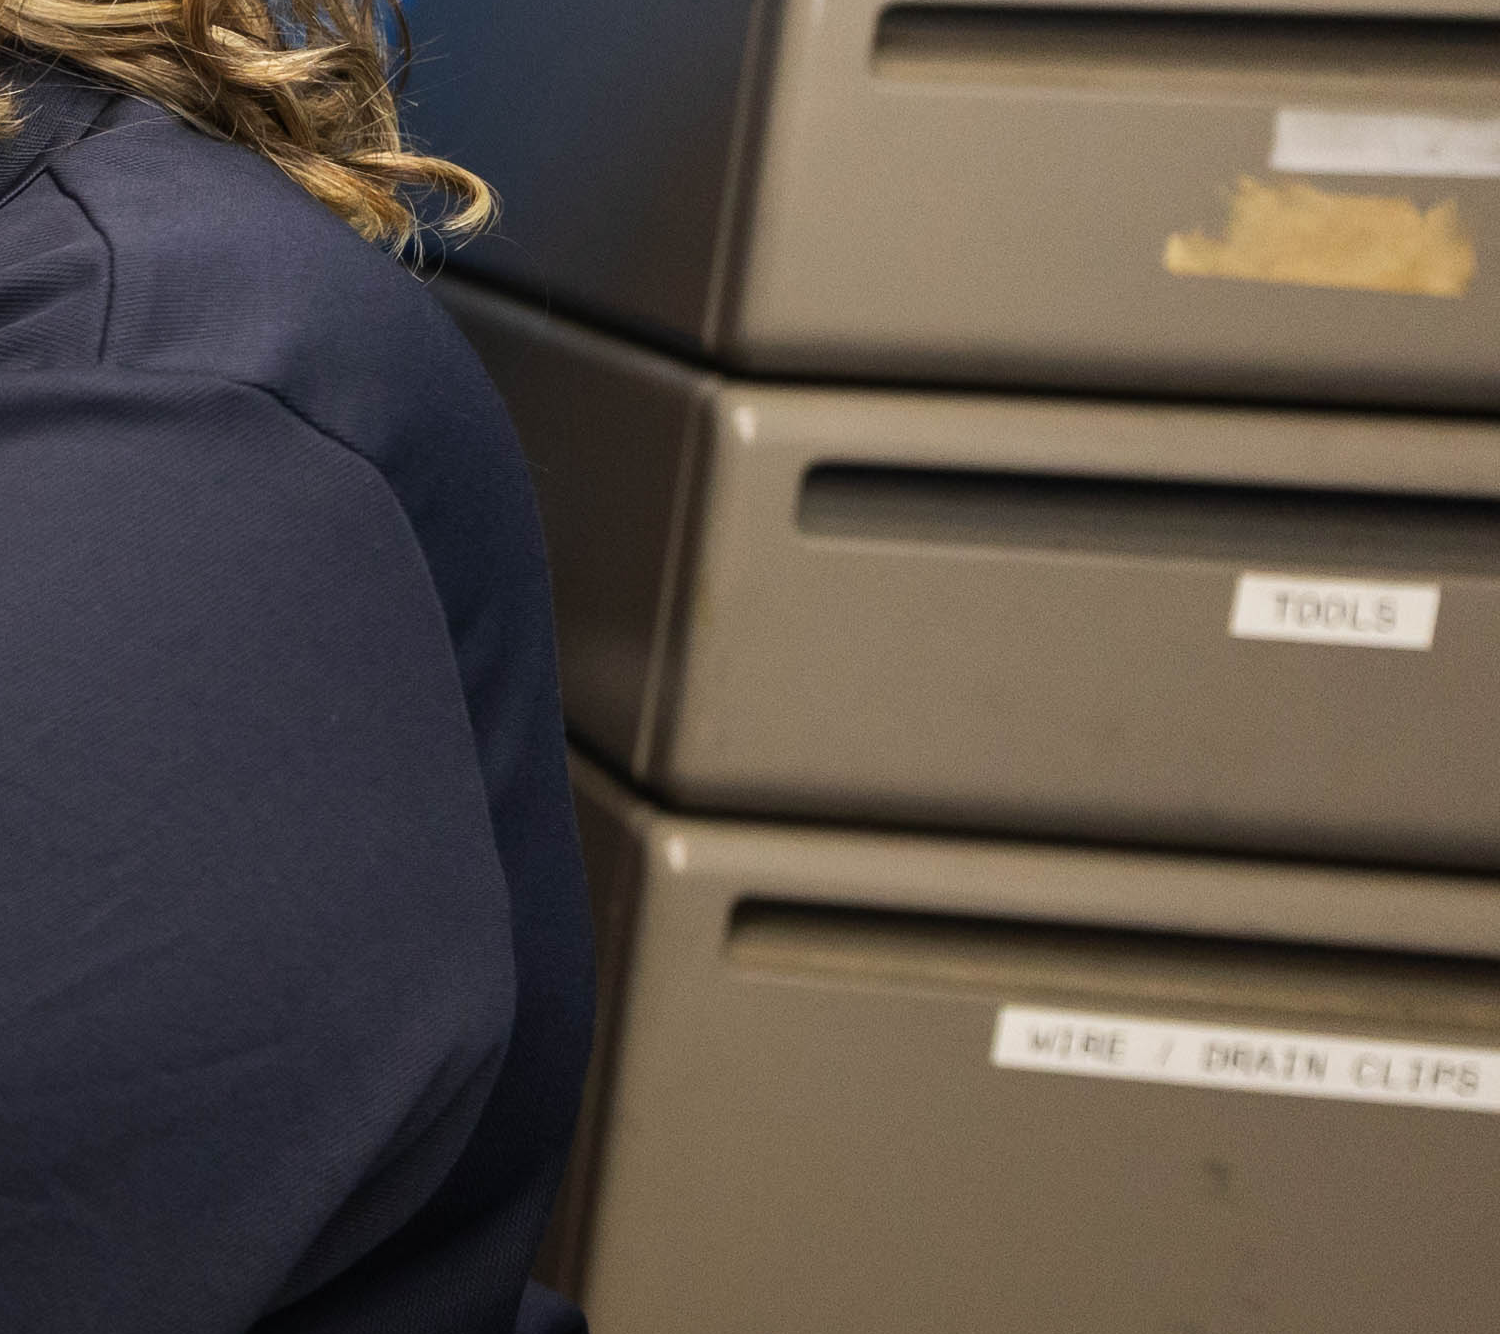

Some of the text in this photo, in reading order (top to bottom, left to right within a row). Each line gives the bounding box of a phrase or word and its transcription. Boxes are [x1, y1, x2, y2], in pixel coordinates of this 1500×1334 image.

[1274, 590, 1398, 634] TOOLS
[1026, 1023, 1127, 1064] WIRE
[1201, 1040, 1329, 1082] DRAIN
[1351, 1053, 1481, 1096] CLIPS
